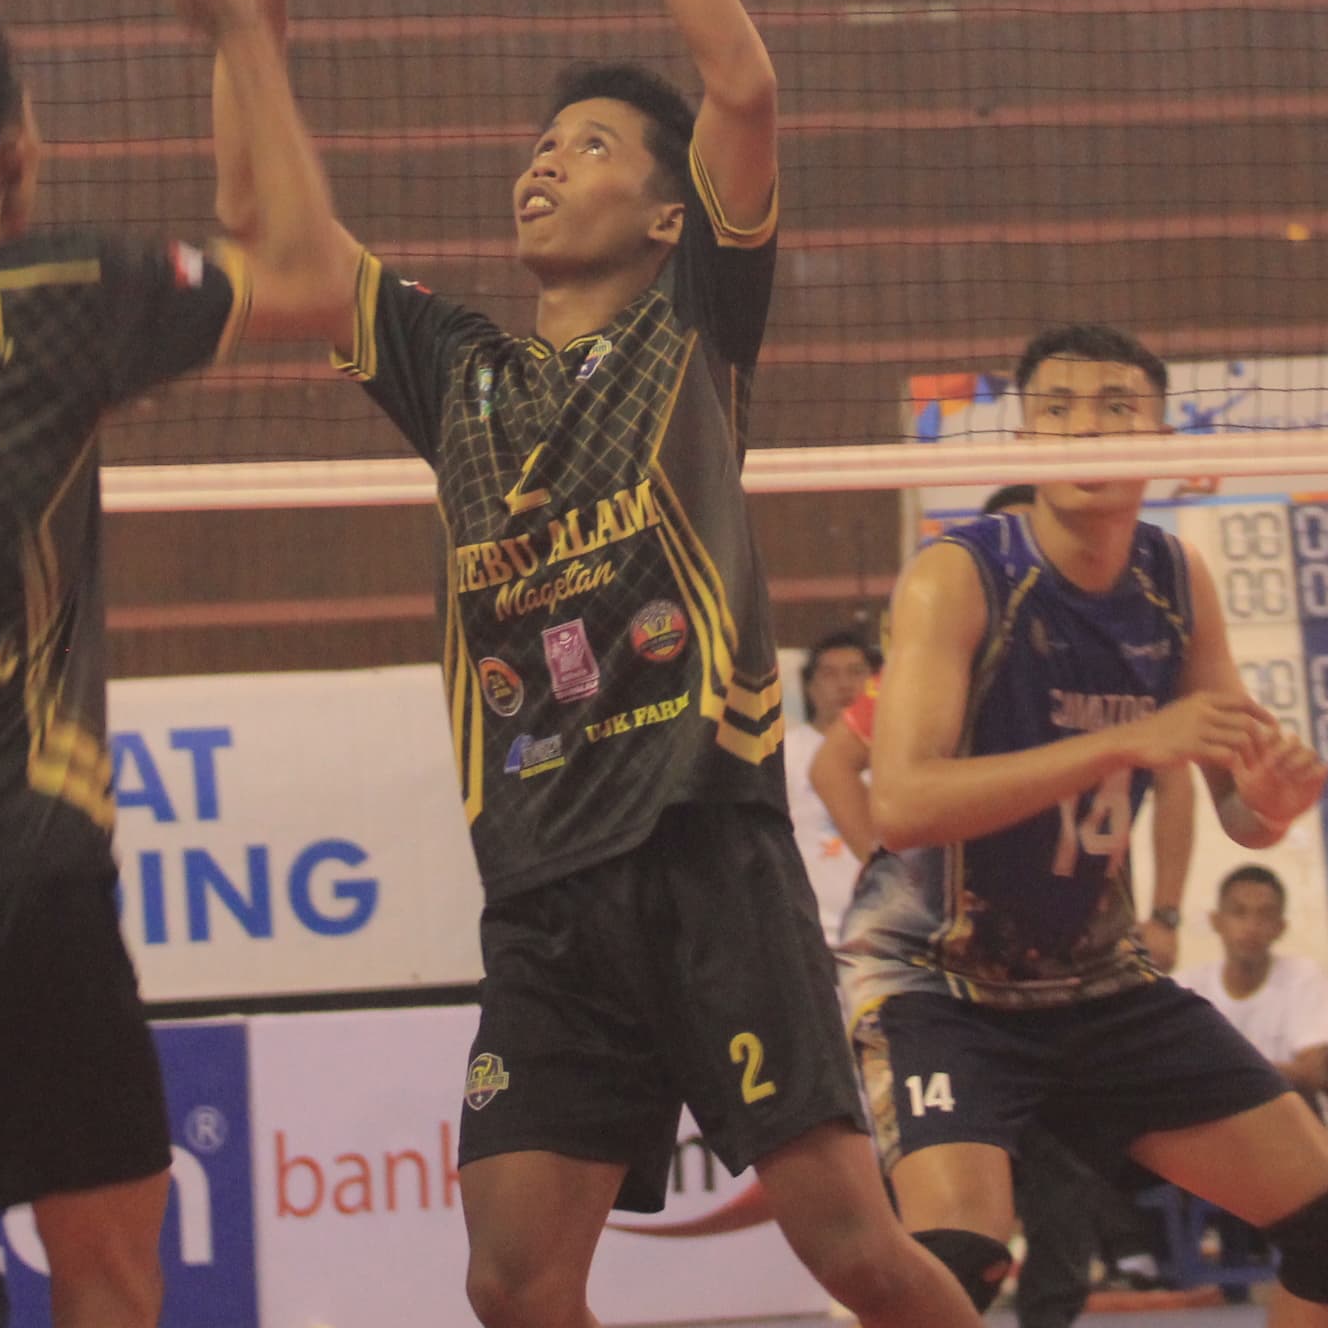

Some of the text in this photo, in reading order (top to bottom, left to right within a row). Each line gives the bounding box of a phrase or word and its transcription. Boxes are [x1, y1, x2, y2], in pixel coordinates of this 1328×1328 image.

[547, 478, 661, 566] ALAM
[495, 560, 617, 622] Magetan
[115, 837, 379, 946] ING
[729, 1032, 776, 1105] 2
[904, 1071, 956, 1117] 14
